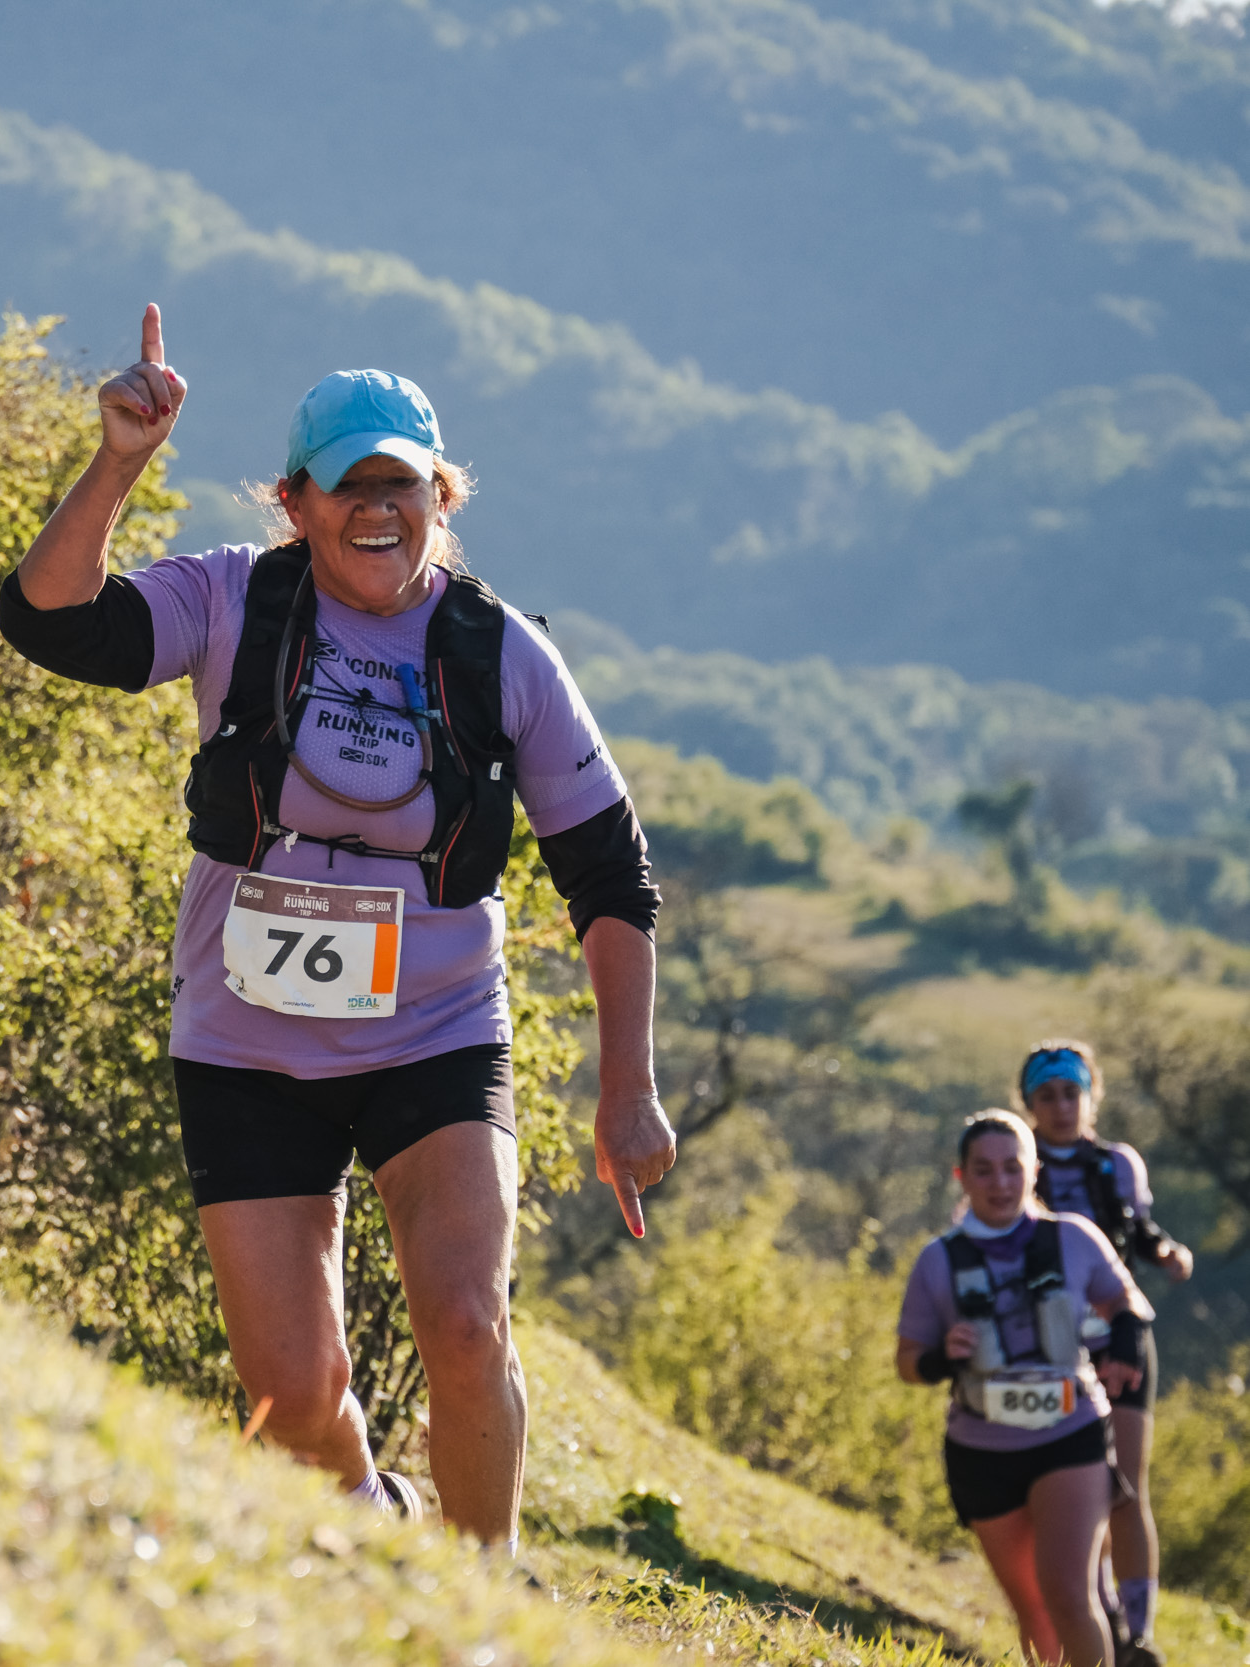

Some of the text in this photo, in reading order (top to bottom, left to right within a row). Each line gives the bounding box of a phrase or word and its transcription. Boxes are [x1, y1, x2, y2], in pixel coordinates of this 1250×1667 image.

[317, 710, 415, 748] RUNNING
[352, 735, 380, 750] TRIP
[365, 756, 388, 768] SOX
[253, 888, 264, 900] SOX
[283, 896, 330, 912] RUNNING
[376, 902, 392, 913] SOX
[300, 909, 312, 917] TRIP
[264, 928, 343, 983] 76
[1003, 1390, 1060, 1413] 806
